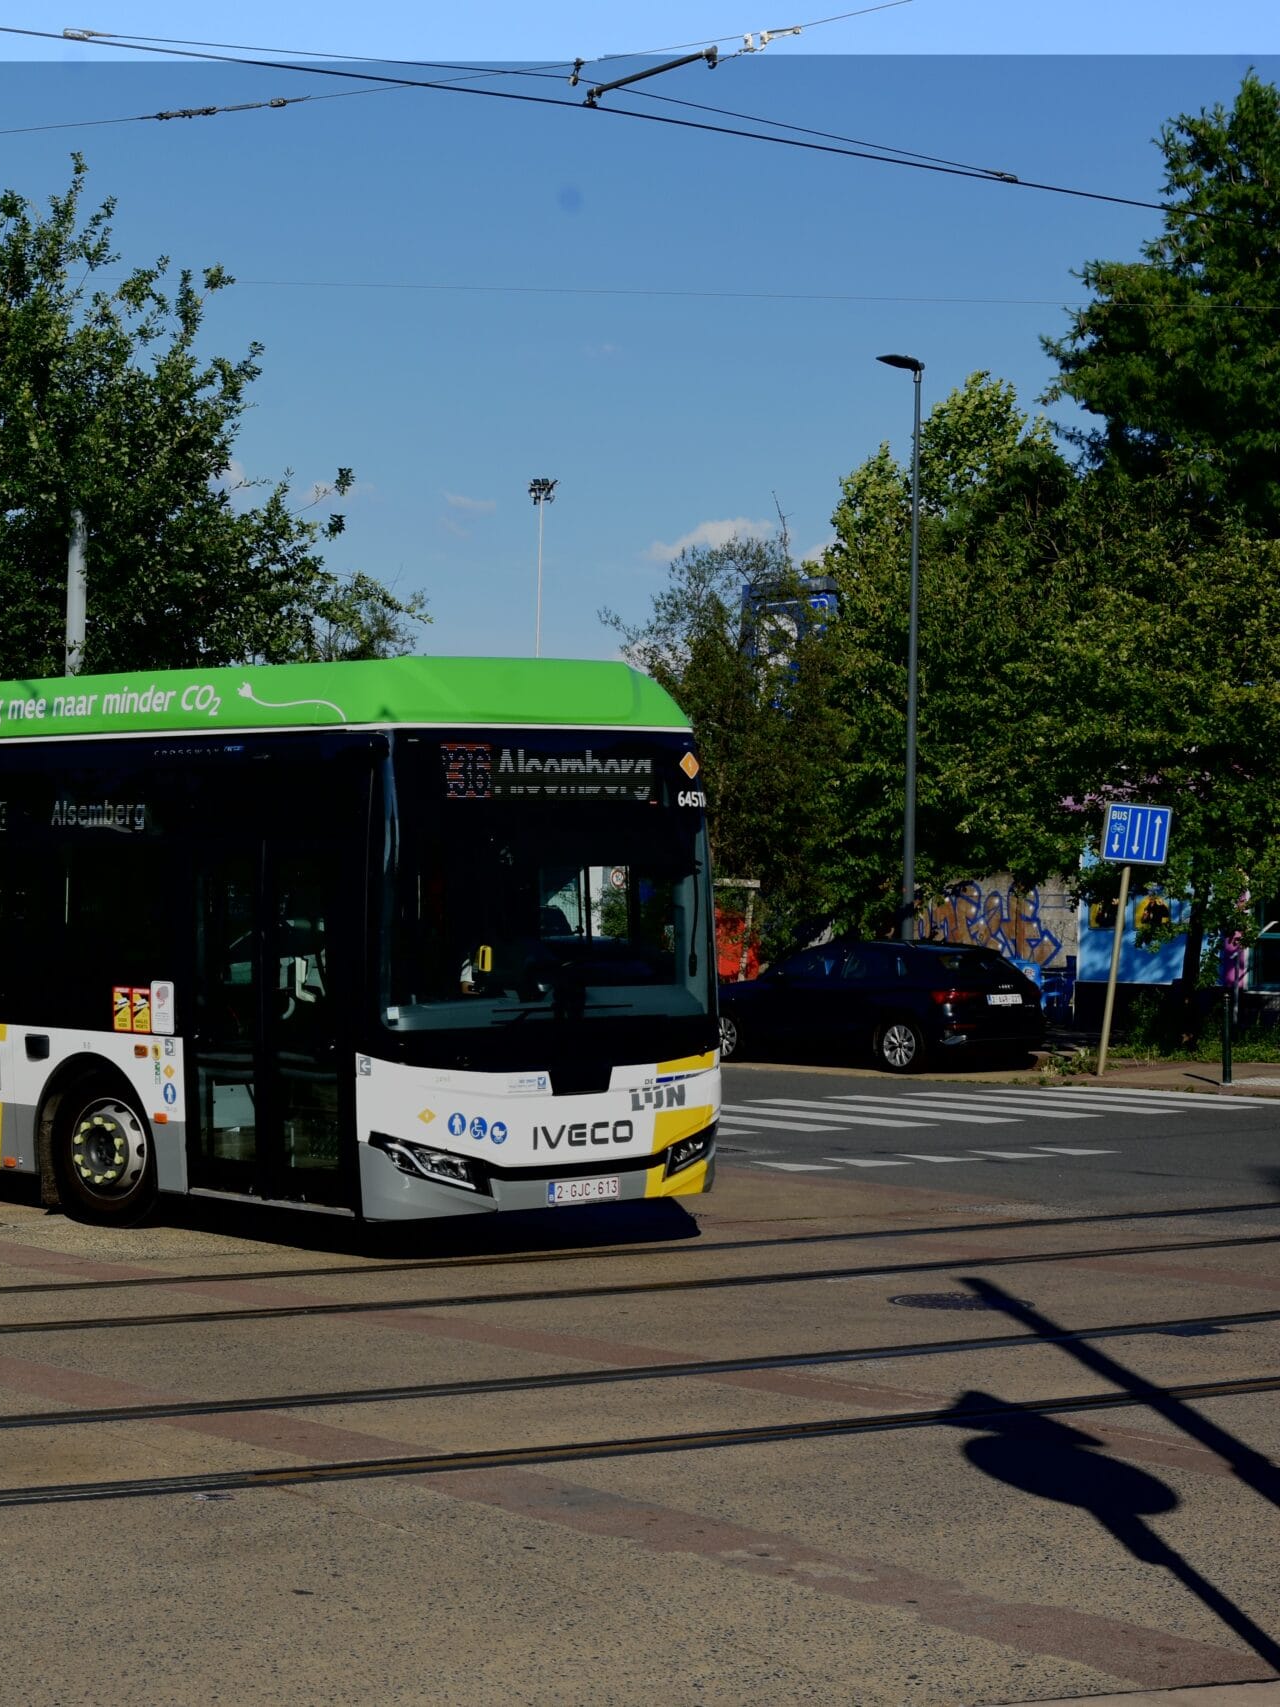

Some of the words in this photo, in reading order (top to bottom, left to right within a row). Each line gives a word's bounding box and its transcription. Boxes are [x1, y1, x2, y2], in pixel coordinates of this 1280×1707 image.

[7, 698, 47, 719] mee
[52, 694, 98, 717] naar
[102, 684, 177, 715] minder
[677, 790, 707, 808] 64511
[50, 798, 146, 831] Alsemberg
[1111, 810, 1128, 820] BUS
[628, 1084, 686, 1112] LIJN
[532, 1119, 634, 1151] IVECO
[556, 1179, 618, 1199] 2-GJC-613
